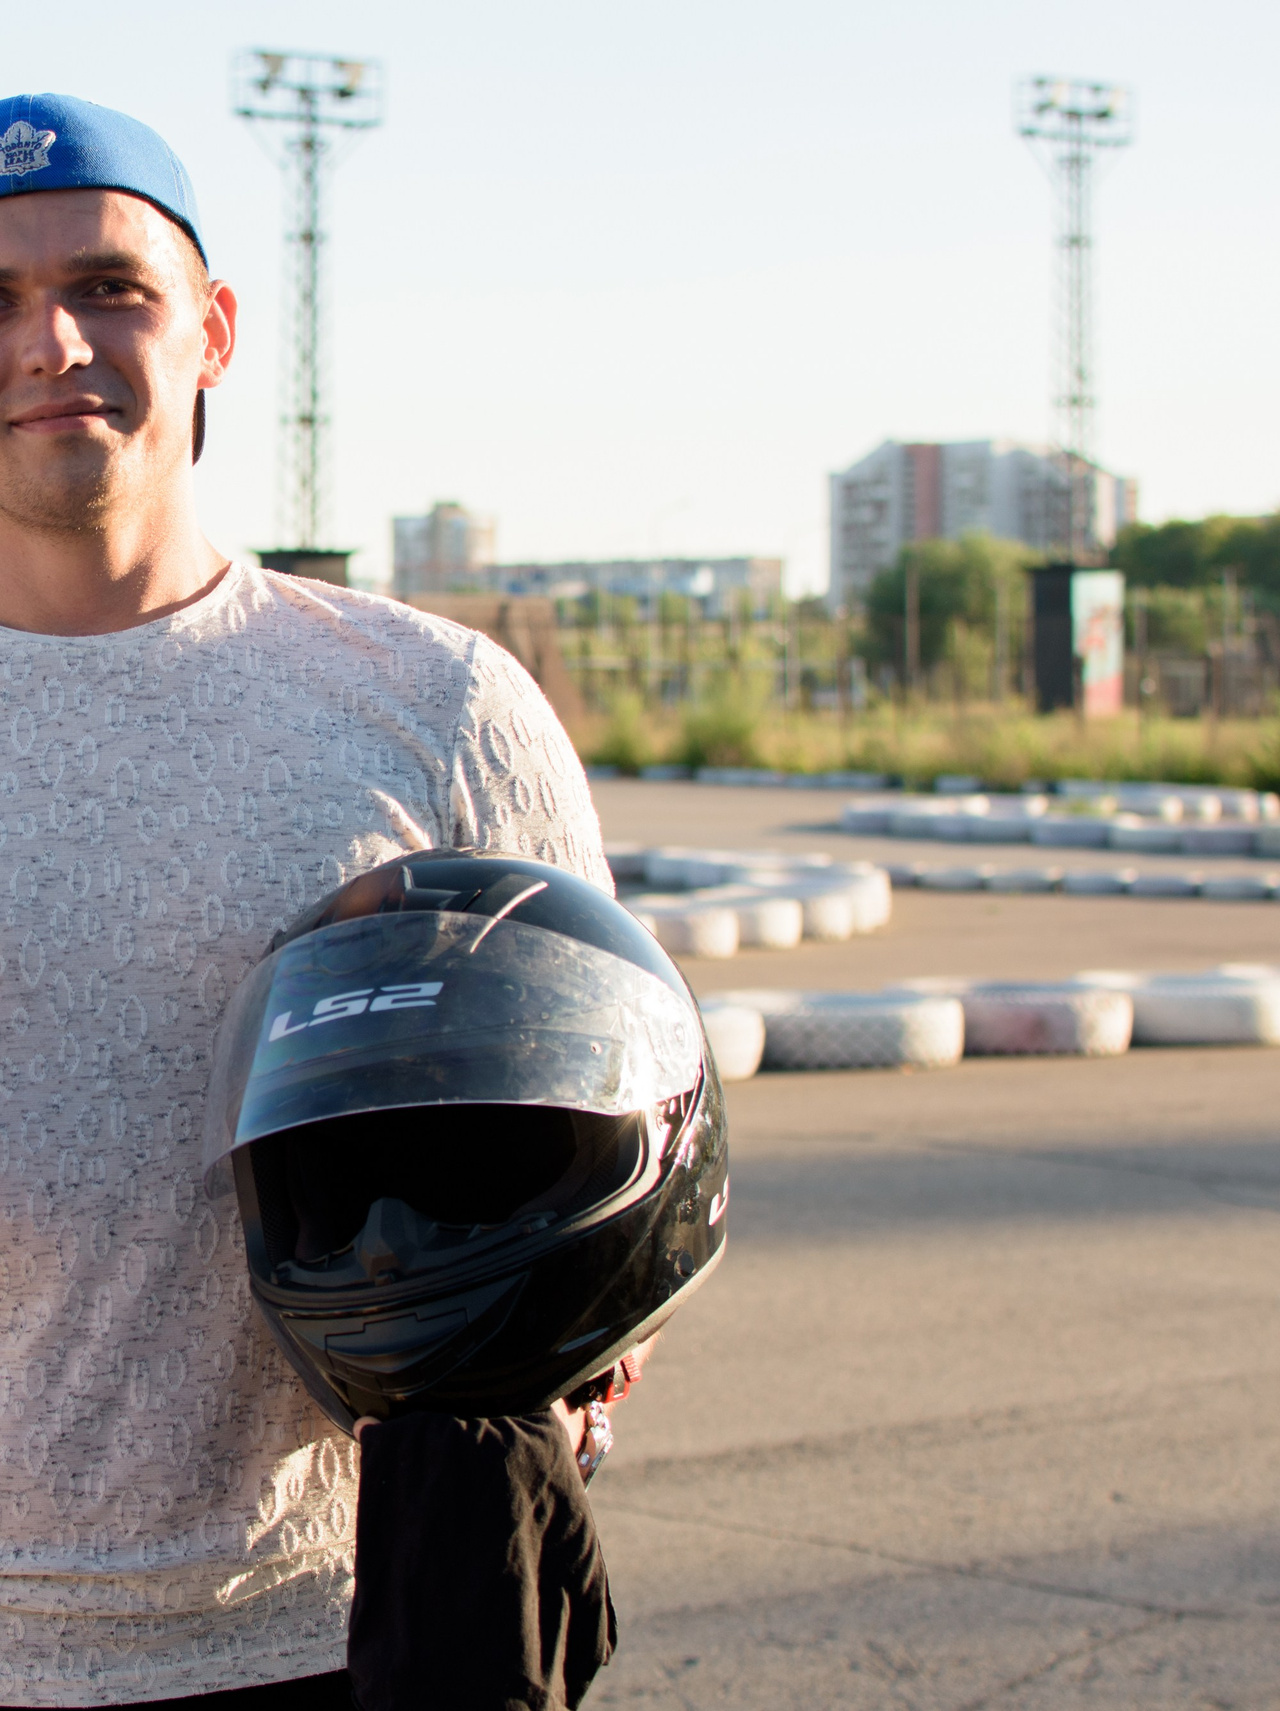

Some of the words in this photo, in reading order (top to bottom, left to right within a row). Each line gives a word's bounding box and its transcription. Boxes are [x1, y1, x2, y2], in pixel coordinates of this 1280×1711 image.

[0, 141, 42, 154] TORONTO
[4, 156, 35, 167] LEAFS
[268, 981, 444, 1042] LS2
